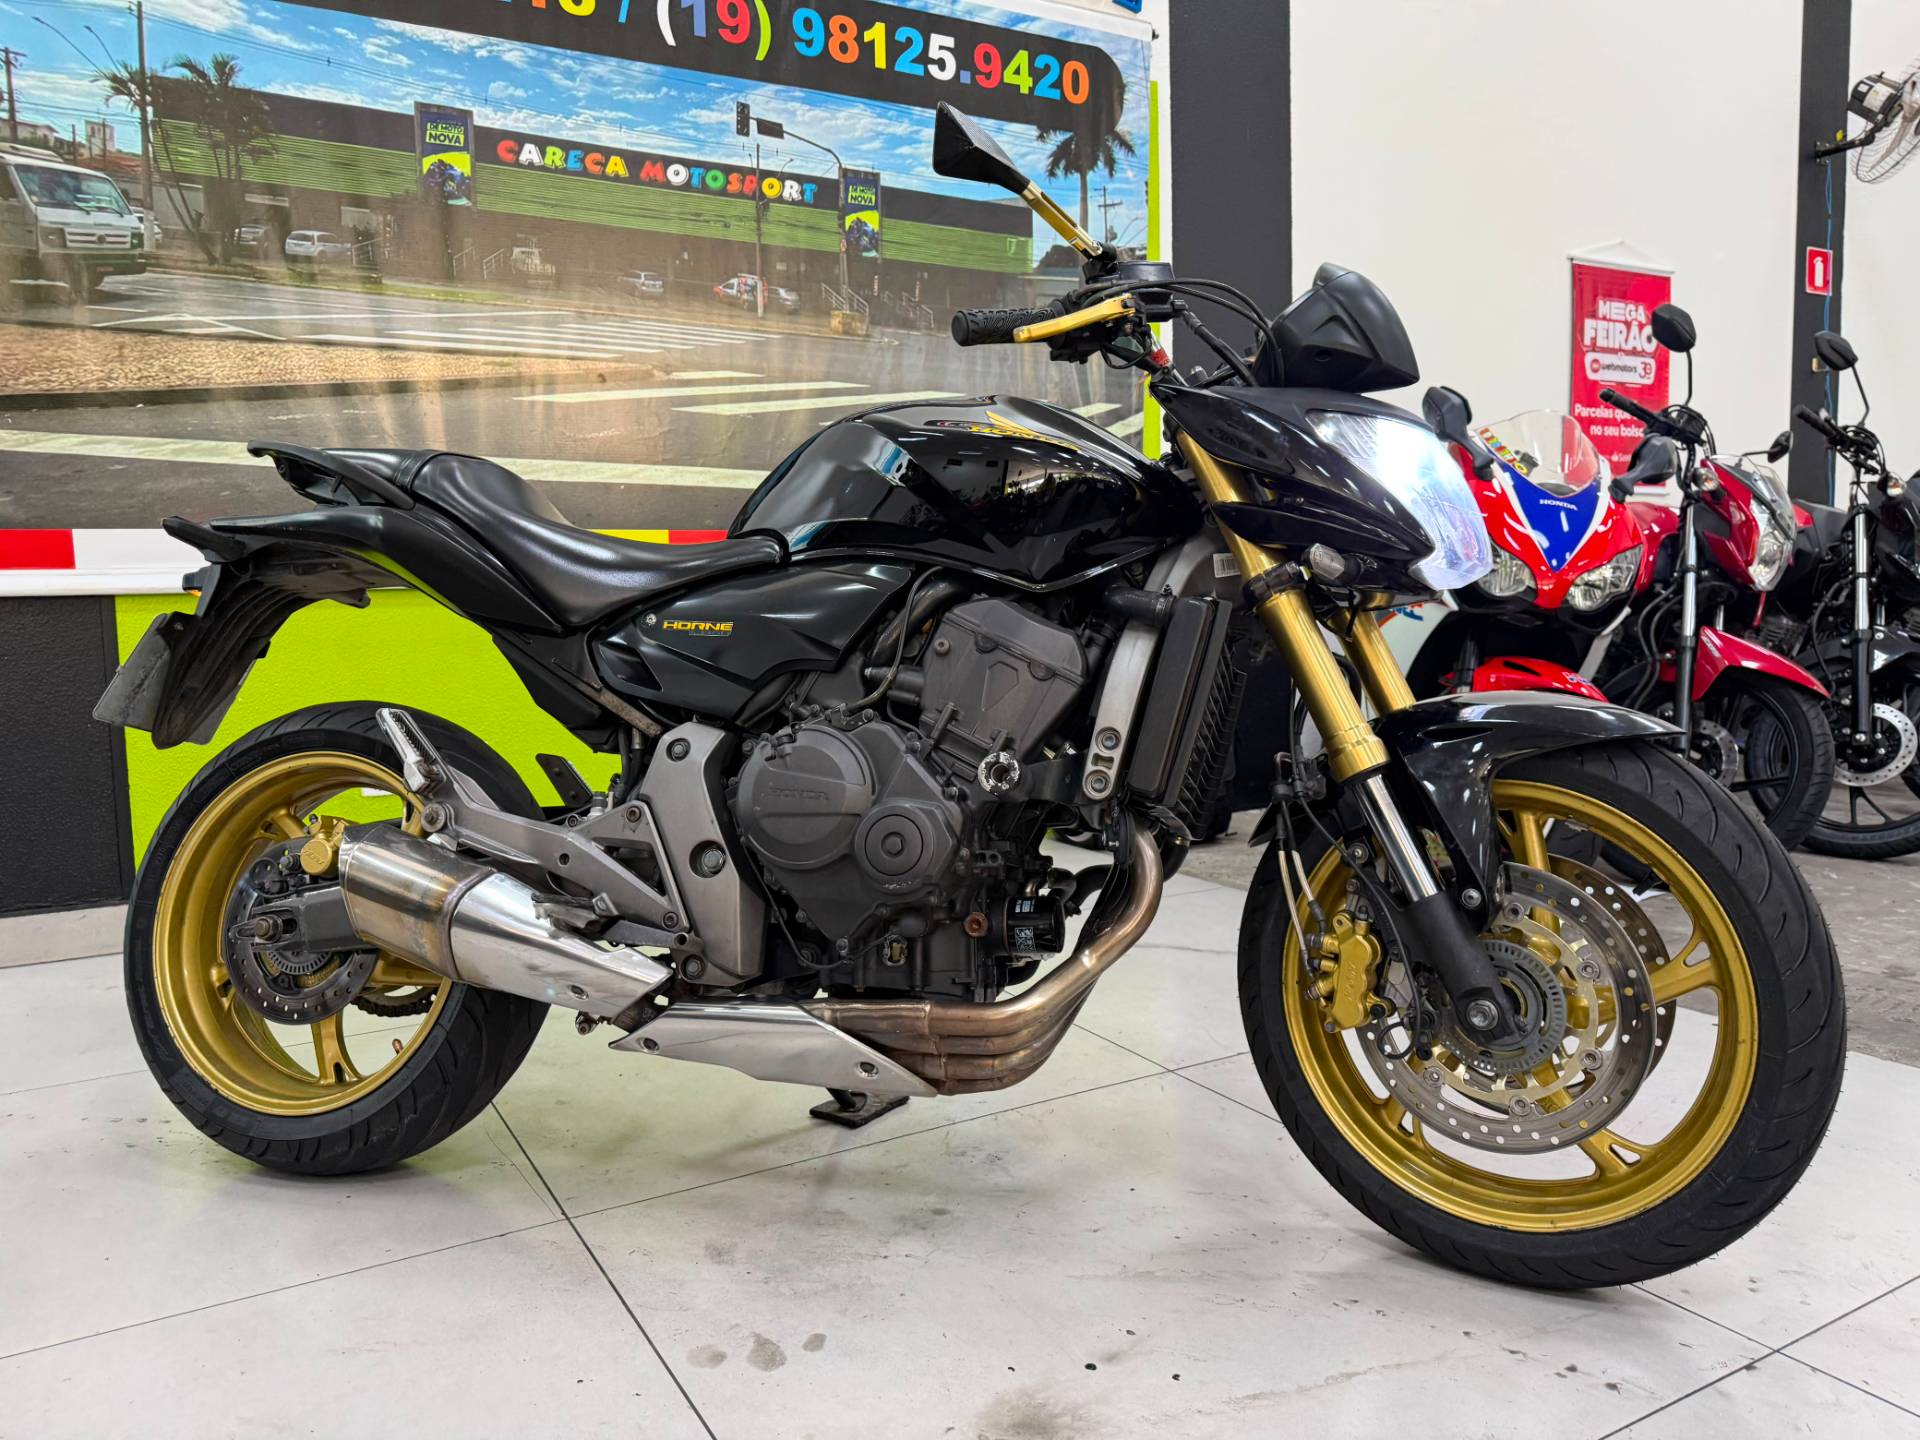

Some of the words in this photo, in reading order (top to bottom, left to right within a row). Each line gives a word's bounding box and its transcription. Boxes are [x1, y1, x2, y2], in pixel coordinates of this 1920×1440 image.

[792, 8, 1090, 104] 98125.9420
[428, 132, 462, 145] NOVA
[497, 140, 629, 177] CARECA
[640, 159, 818, 204] MOTOSPORT
[850, 193, 874, 205] NOVA
[1598, 299, 1646, 323] MEGA
[1575, 403, 1613, 418] Parcelas
[1590, 425, 1602, 436] no
[1604, 426, 1619, 437] seu
[1539, 499, 1578, 511] HONDA
